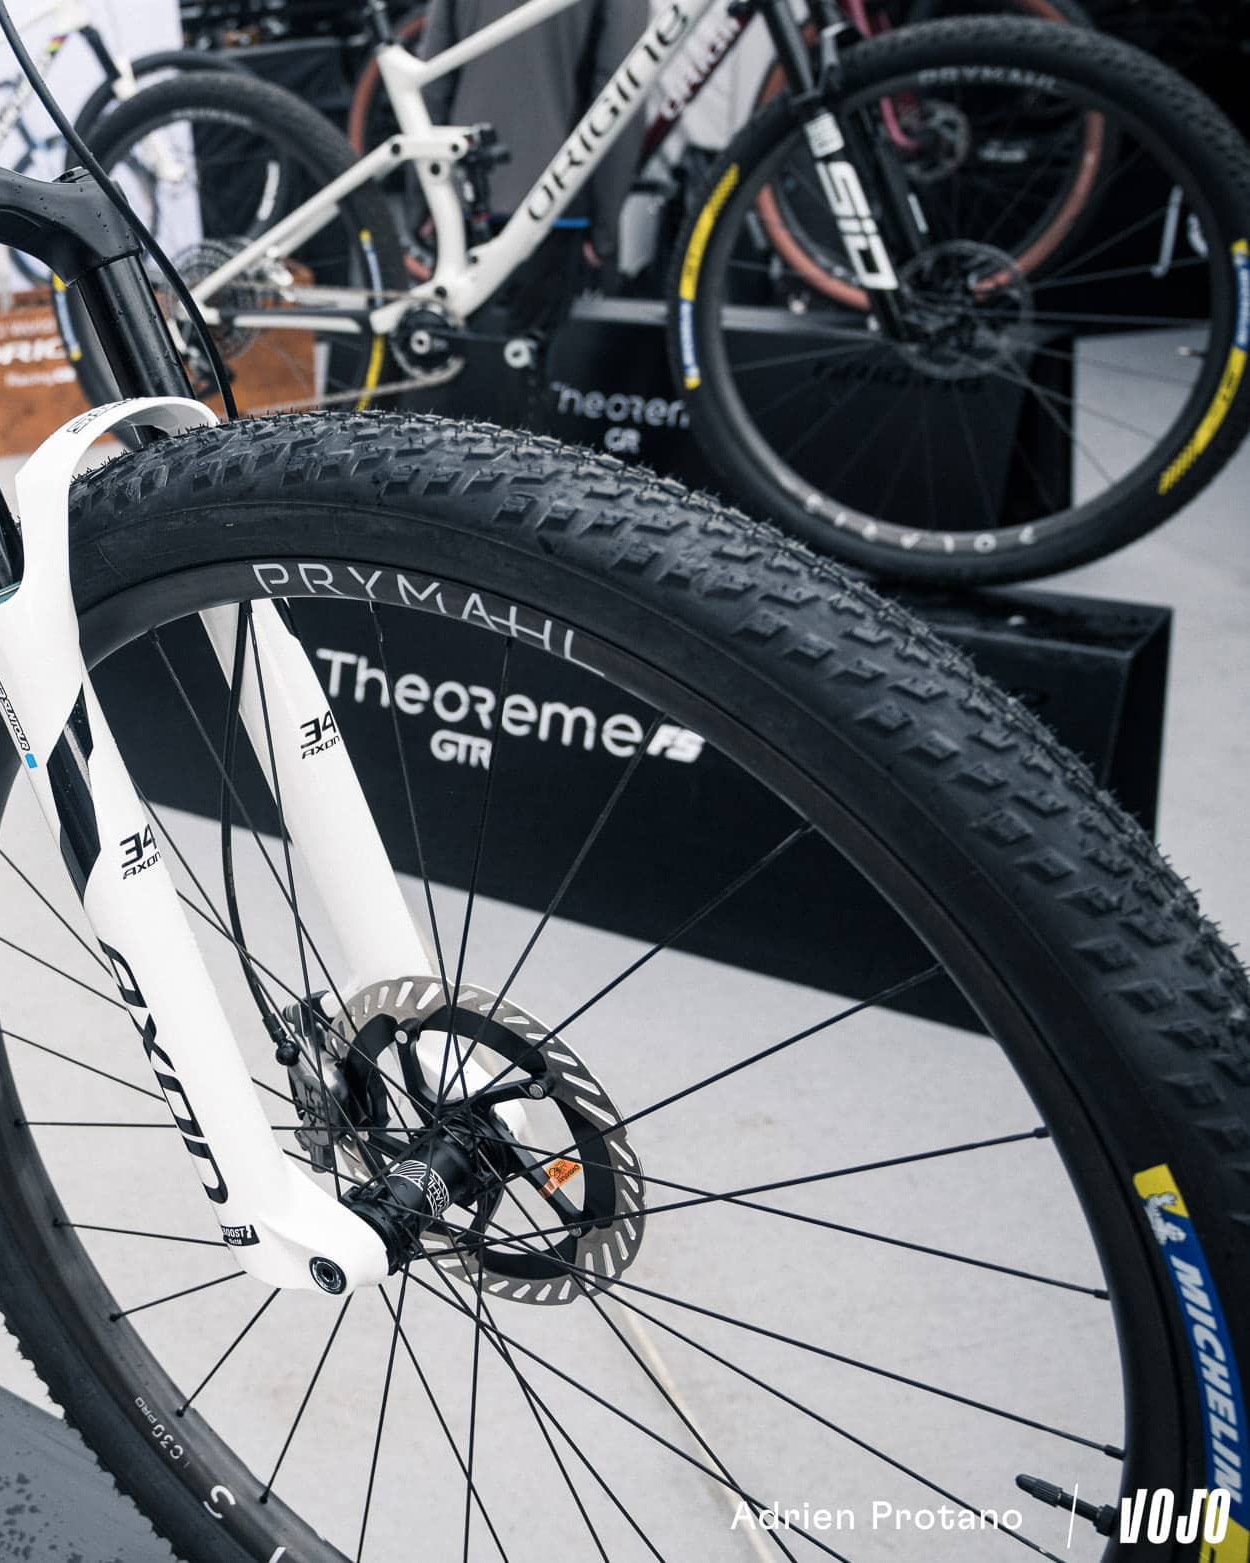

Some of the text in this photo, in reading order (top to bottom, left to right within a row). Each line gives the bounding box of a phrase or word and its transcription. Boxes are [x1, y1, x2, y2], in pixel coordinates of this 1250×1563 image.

[814, 161, 899, 289] SID
[252, 562, 605, 677] PRYMAHL
[300, 710, 337, 750] 34
[429, 728, 493, 771] GTR
[119, 823, 158, 869] 34
[1171, 1255, 1243, 1505] MICHELIN
